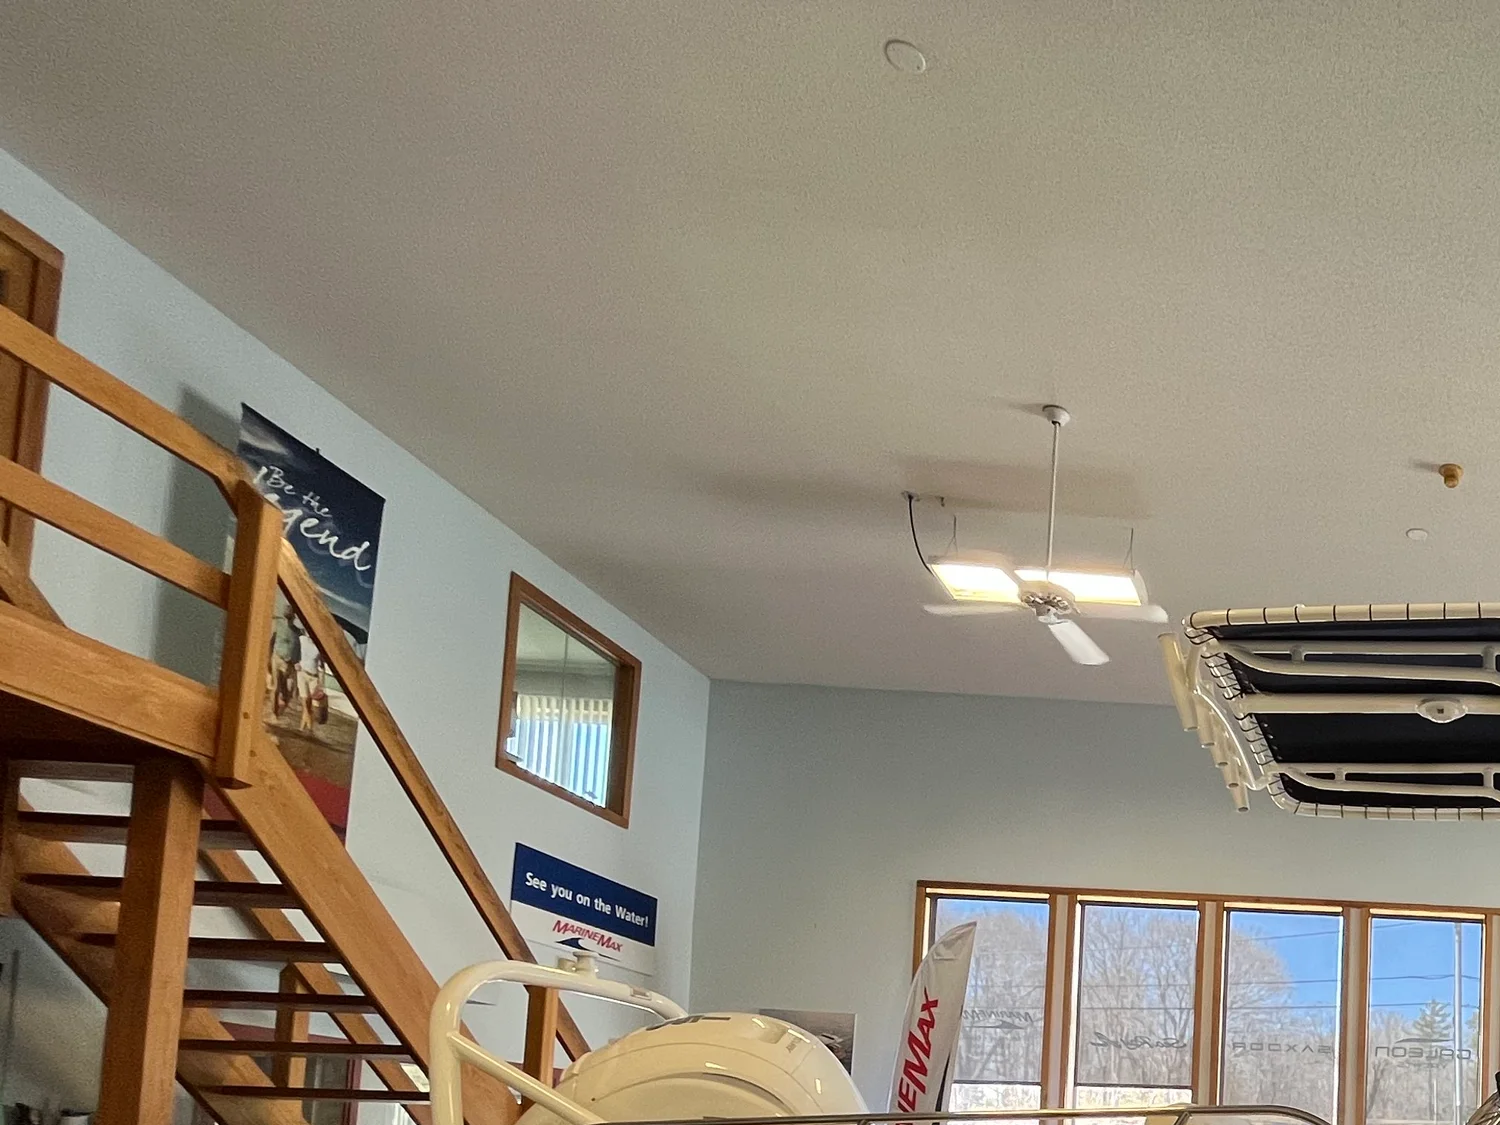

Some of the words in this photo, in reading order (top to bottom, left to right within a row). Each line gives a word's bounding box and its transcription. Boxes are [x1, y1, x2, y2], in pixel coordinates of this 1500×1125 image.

[266, 465, 296, 494] Be
[302, 491, 333, 517] the
[525, 872, 548, 891] See
[550, 883, 573, 900] you
[576, 893, 591, 907] on
[594, 898, 612, 914] the
[615, 904, 649, 927] Water!
